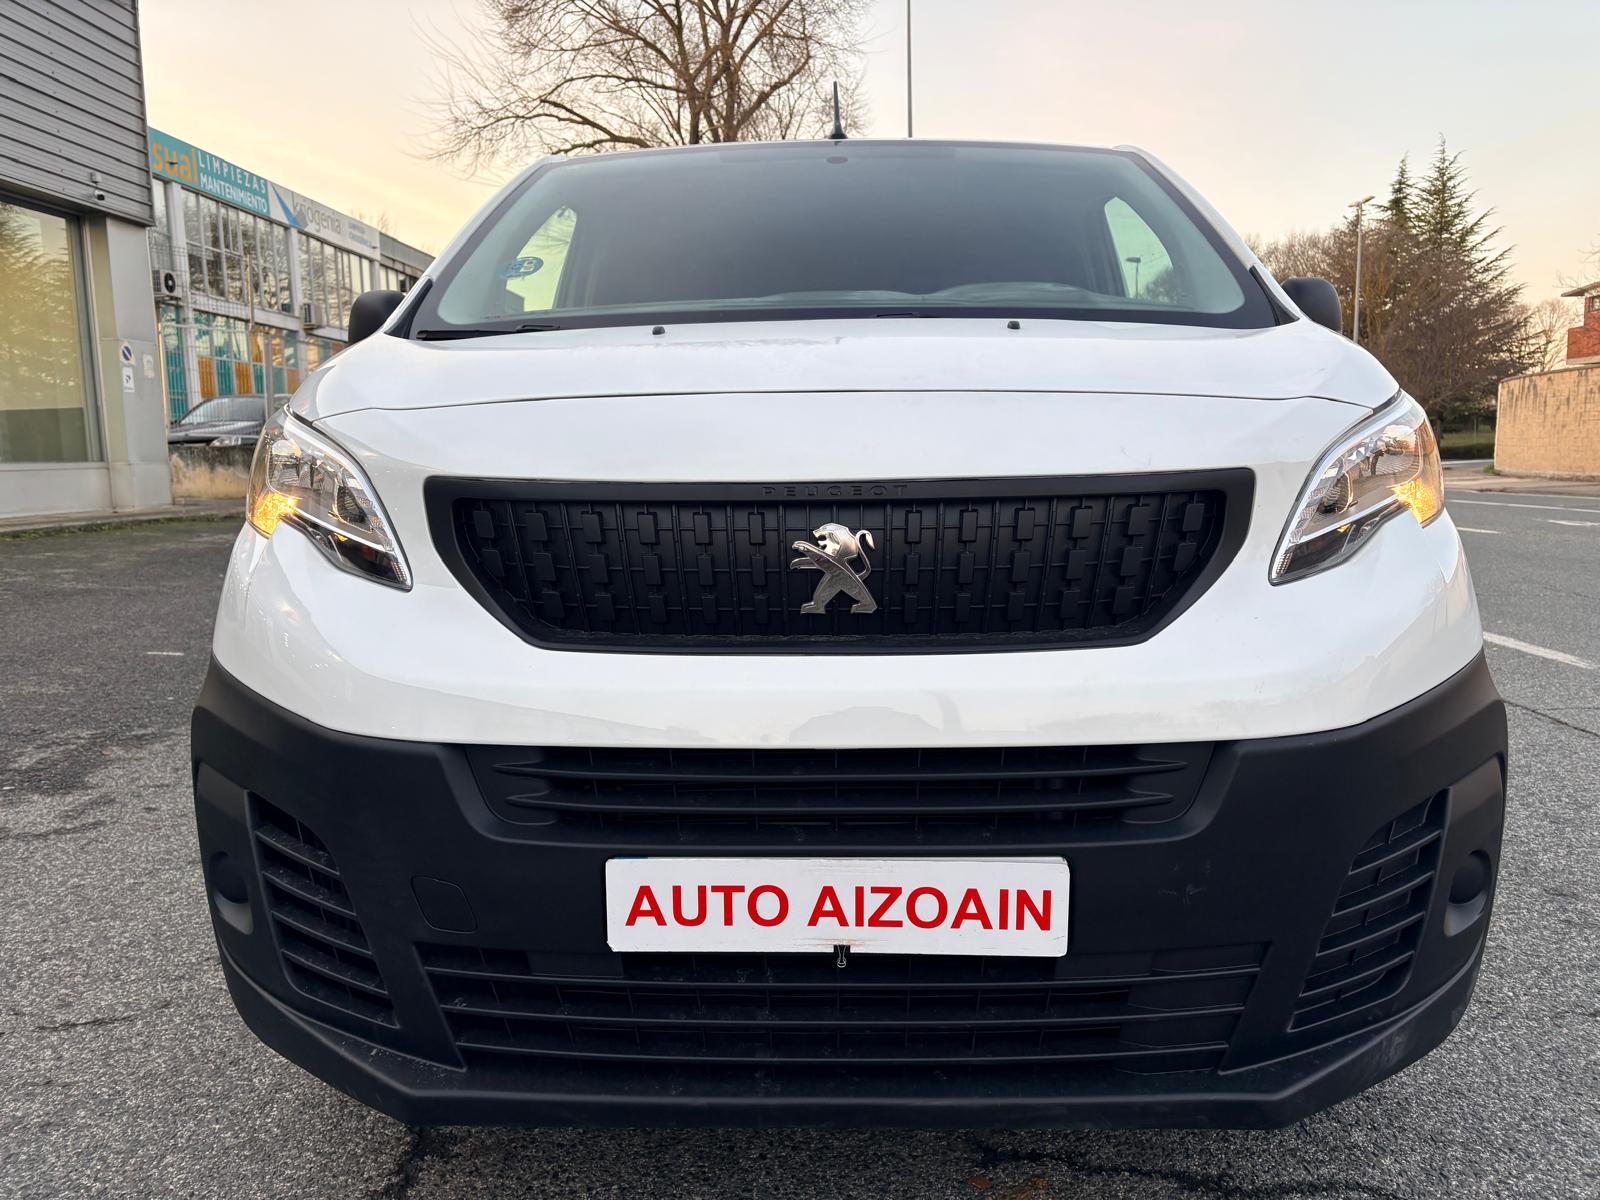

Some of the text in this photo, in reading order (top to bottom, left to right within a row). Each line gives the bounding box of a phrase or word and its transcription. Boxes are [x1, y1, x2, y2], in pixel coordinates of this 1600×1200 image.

[198, 150, 265, 194] LIMPIEZAS
[200, 173, 268, 213] MANTENIMIENTO
[762, 484, 908, 497] PEUGEOT
[625, 884, 1053, 931] AUTO AIZOAIN
